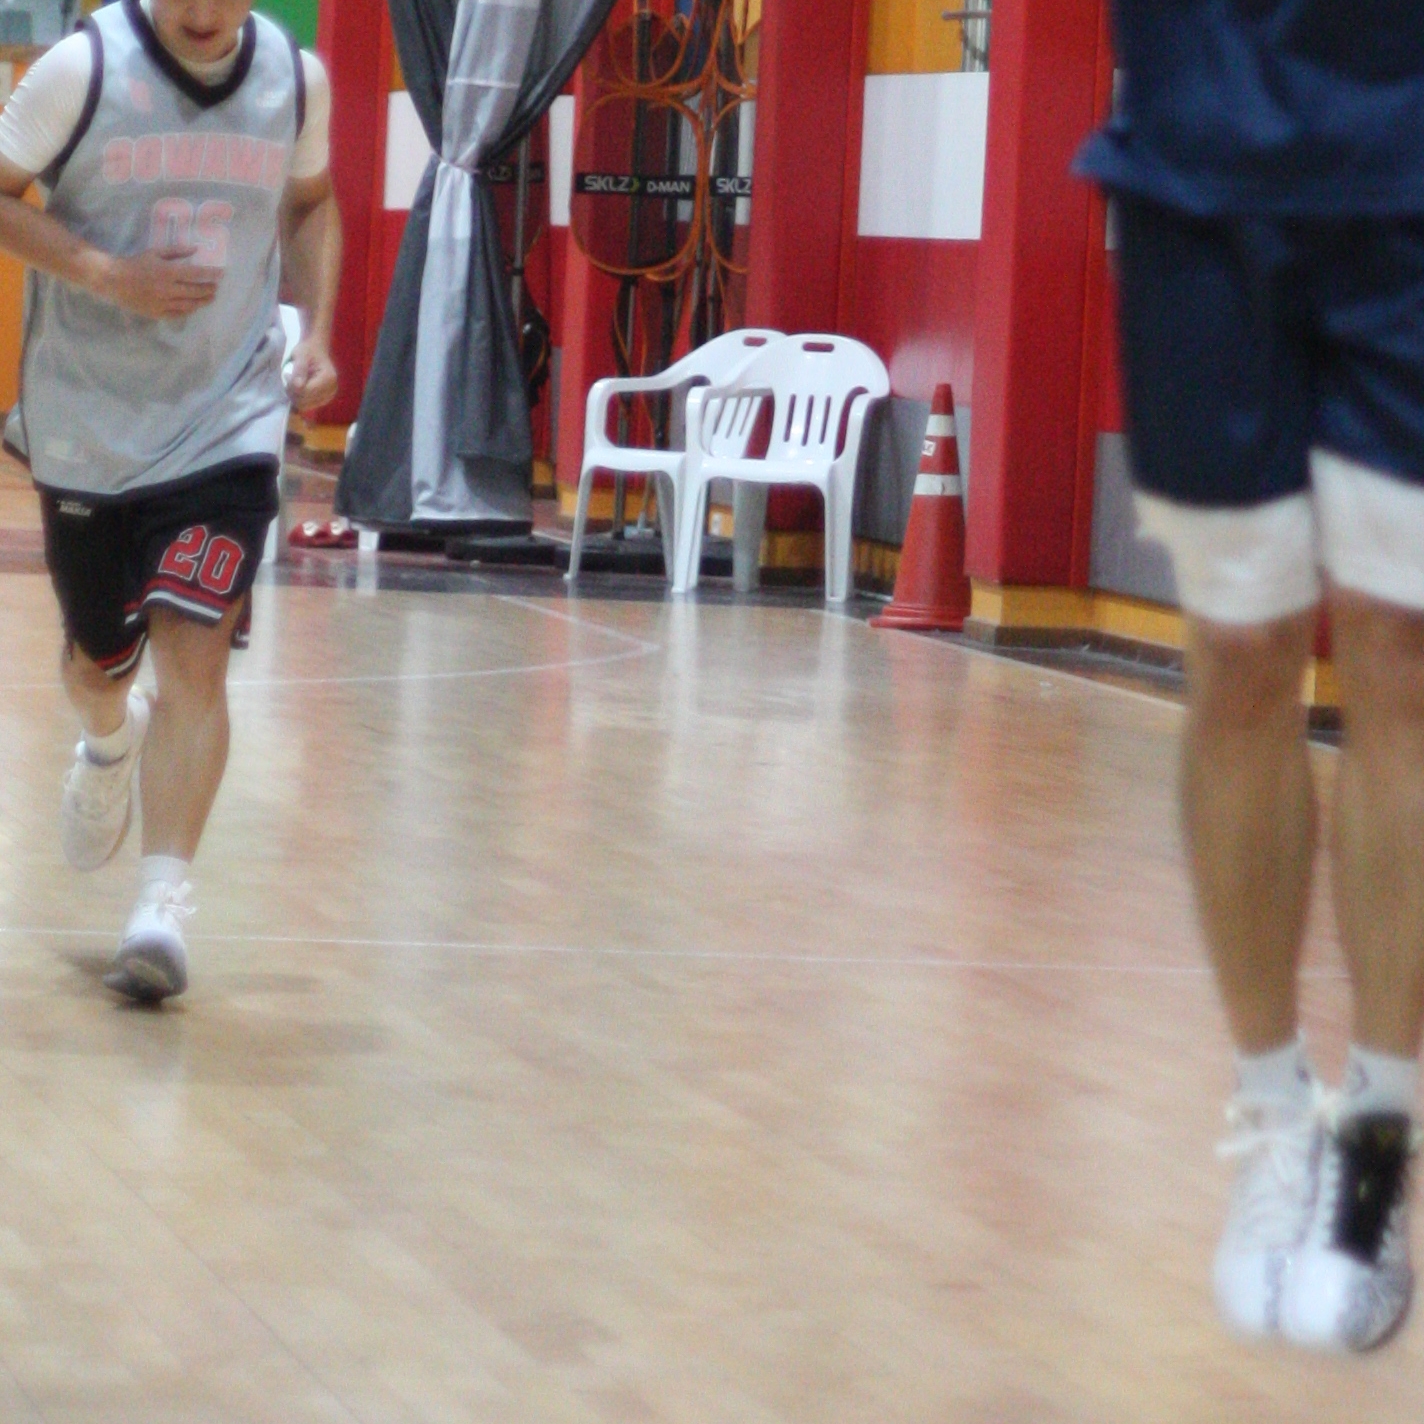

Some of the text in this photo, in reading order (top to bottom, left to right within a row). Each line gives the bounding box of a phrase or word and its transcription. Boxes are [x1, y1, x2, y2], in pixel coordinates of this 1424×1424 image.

[584, 176, 691, 193] SKLZ D-MAN
[158, 525, 244, 594] 20
